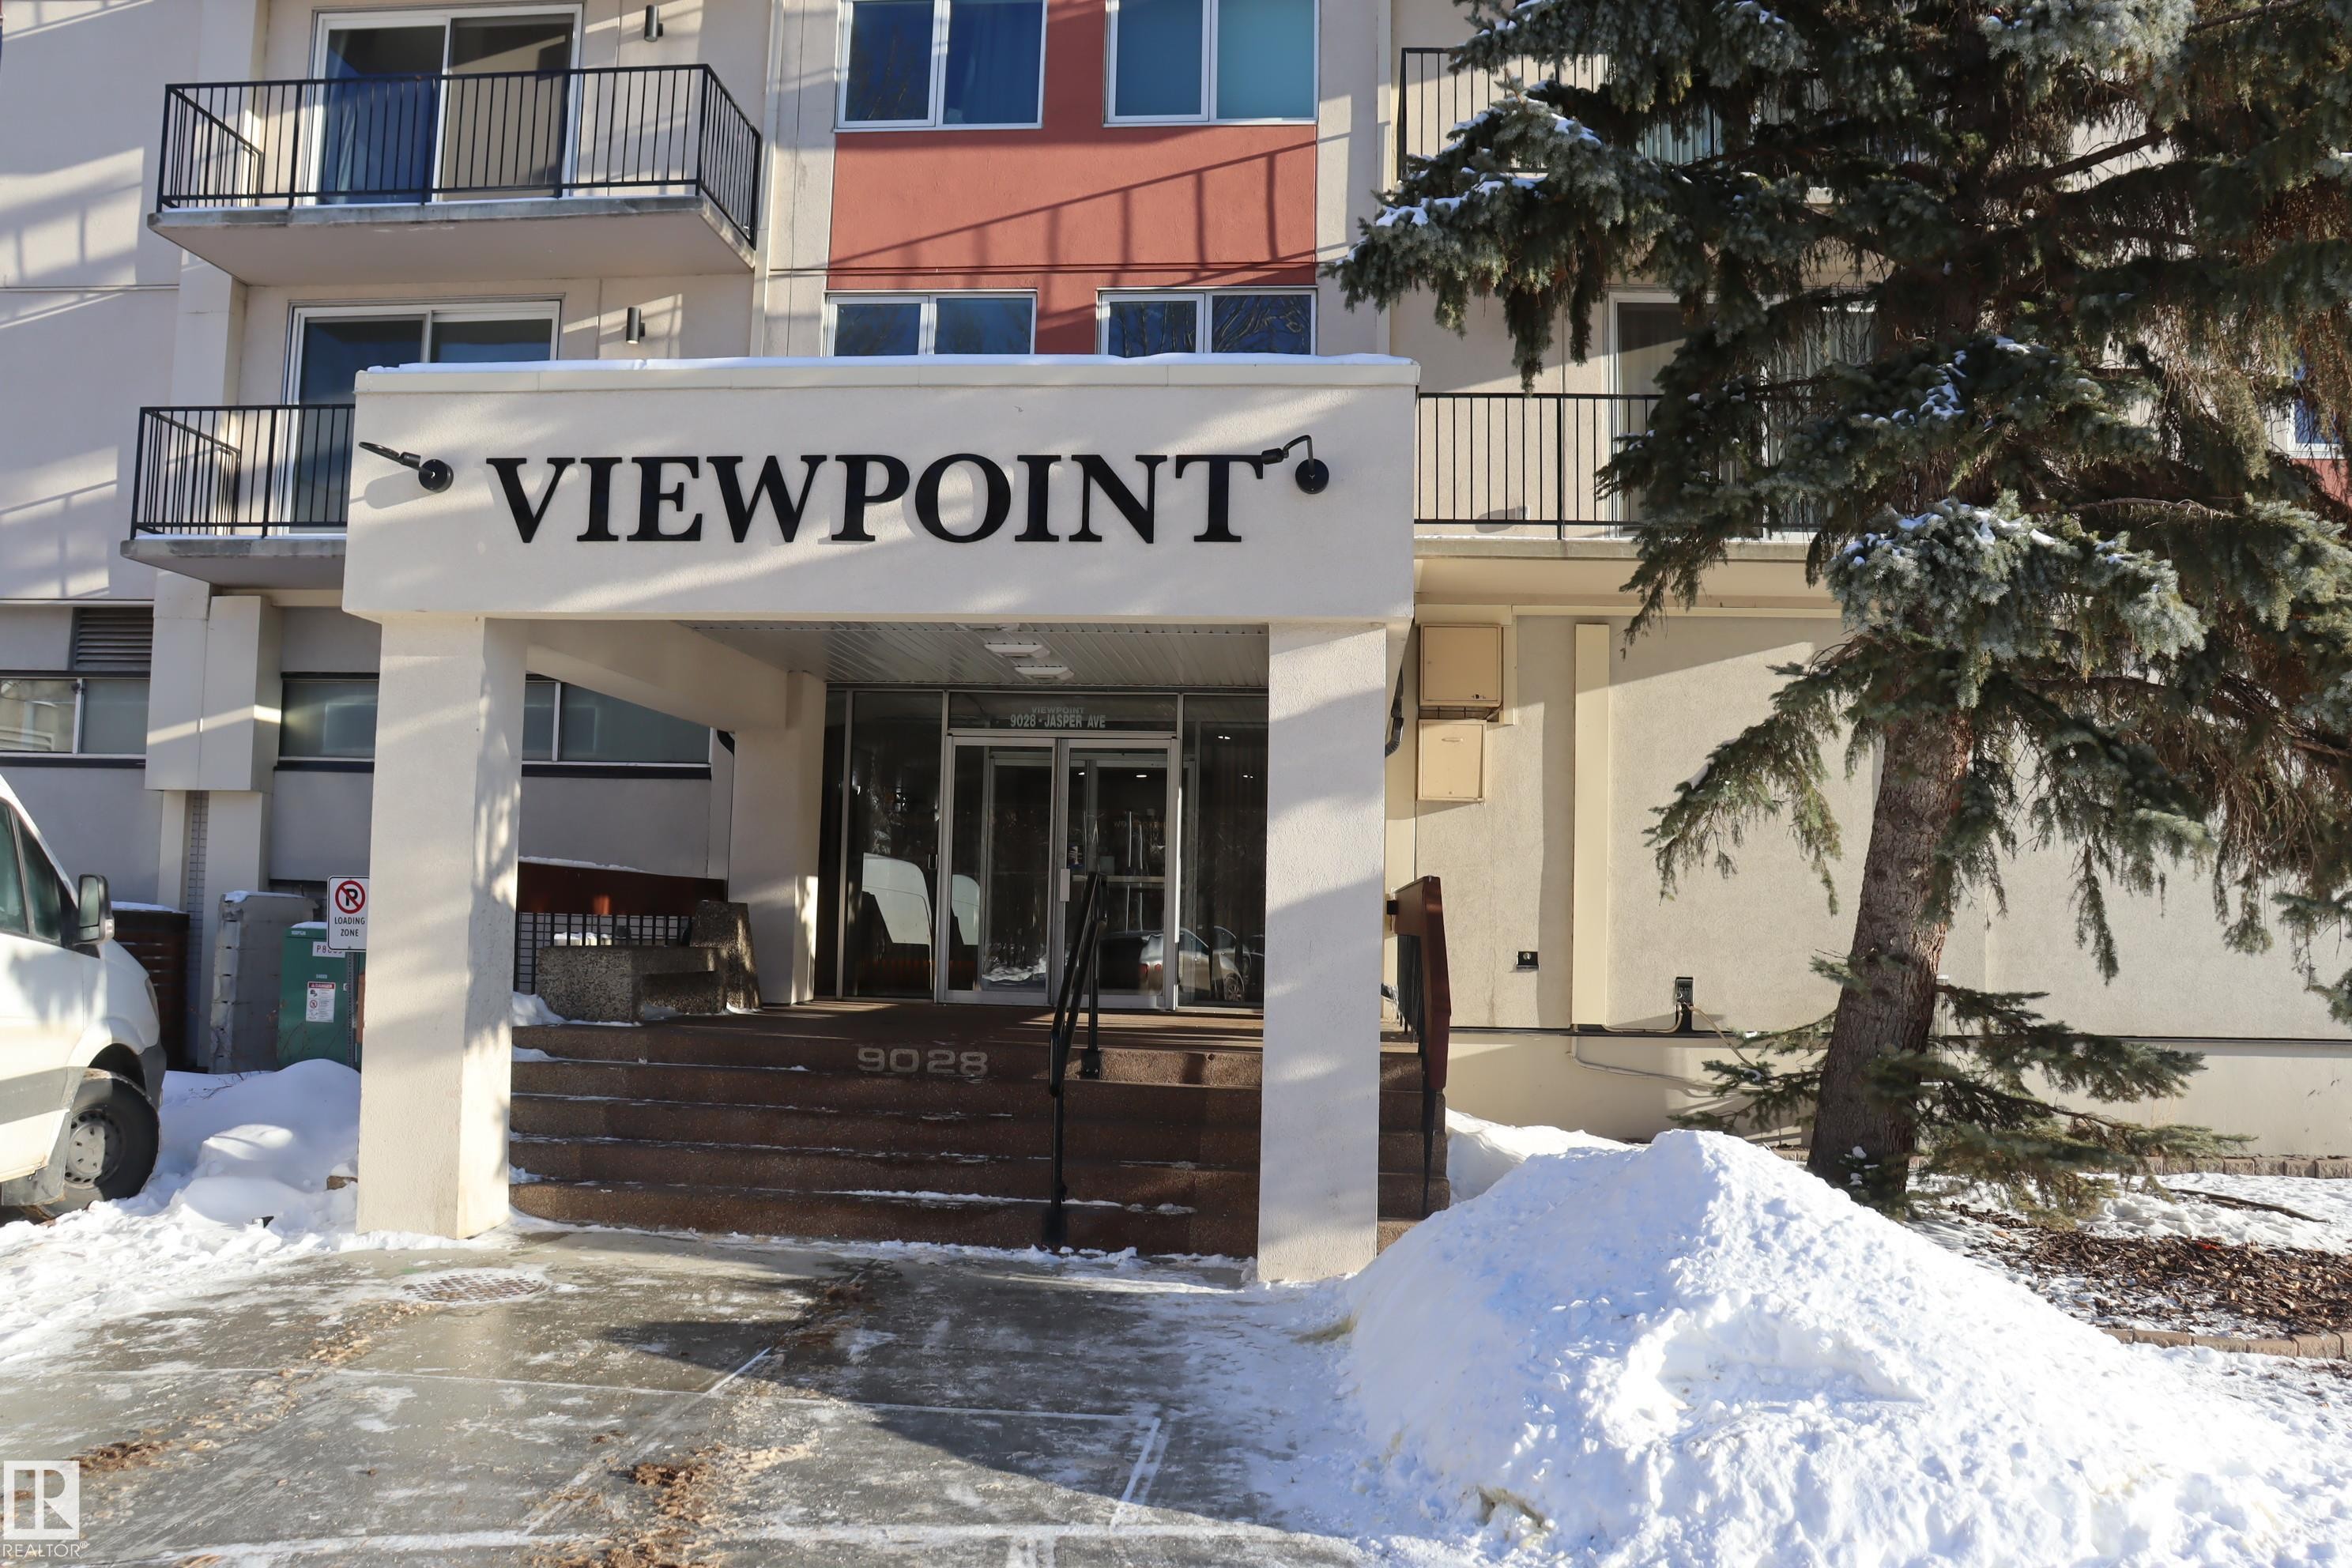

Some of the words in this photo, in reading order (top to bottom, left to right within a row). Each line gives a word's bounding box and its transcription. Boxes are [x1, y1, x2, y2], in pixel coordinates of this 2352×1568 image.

[486, 454, 1264, 543] VIEWPOINT
[1010, 714, 1036, 727] 9028
[1044, 714, 1083, 728] JASPER
[1087, 714, 1106, 729] AVE
[858, 1047, 988, 1076] 9028
